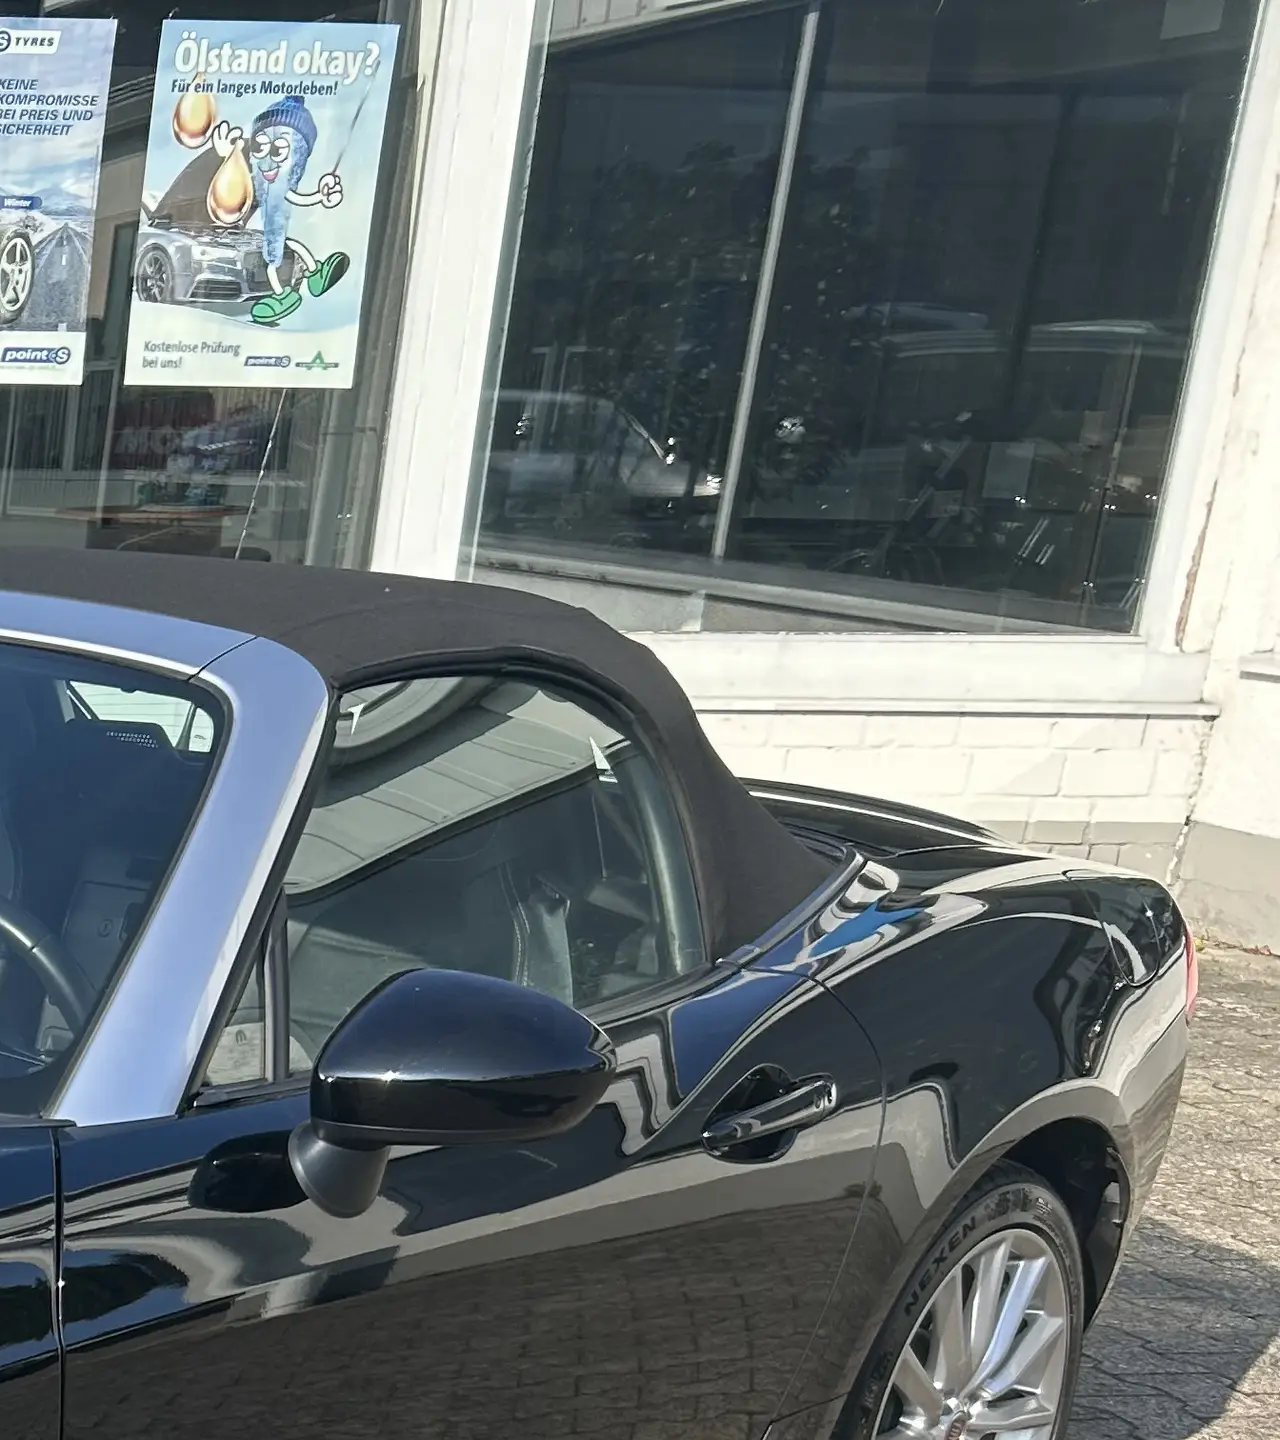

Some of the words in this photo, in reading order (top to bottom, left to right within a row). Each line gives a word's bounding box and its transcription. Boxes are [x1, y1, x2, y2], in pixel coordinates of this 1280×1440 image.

[14, 36, 55, 47] TYRES
[174, 30, 288, 75] Ölstand
[292, 41, 380, 85] okay?
[171, 79, 191, 93] Für
[194, 79, 214, 93] ein
[216, 79, 257, 96] langes
[259, 79, 339, 97] Motorleben!
[18, 109, 58, 121] PREIS
[61, 109, 94, 121] UND
[4, 197, 32, 207] Winter
[5, 349, 48, 362] point
[143, 341, 199, 353] Kostenlose
[200, 342, 241, 357] Prüfung
[142, 356, 158, 368] bei
[160, 357, 182, 369] uns!
[904, 1216, 977, 1316] NEXEN
